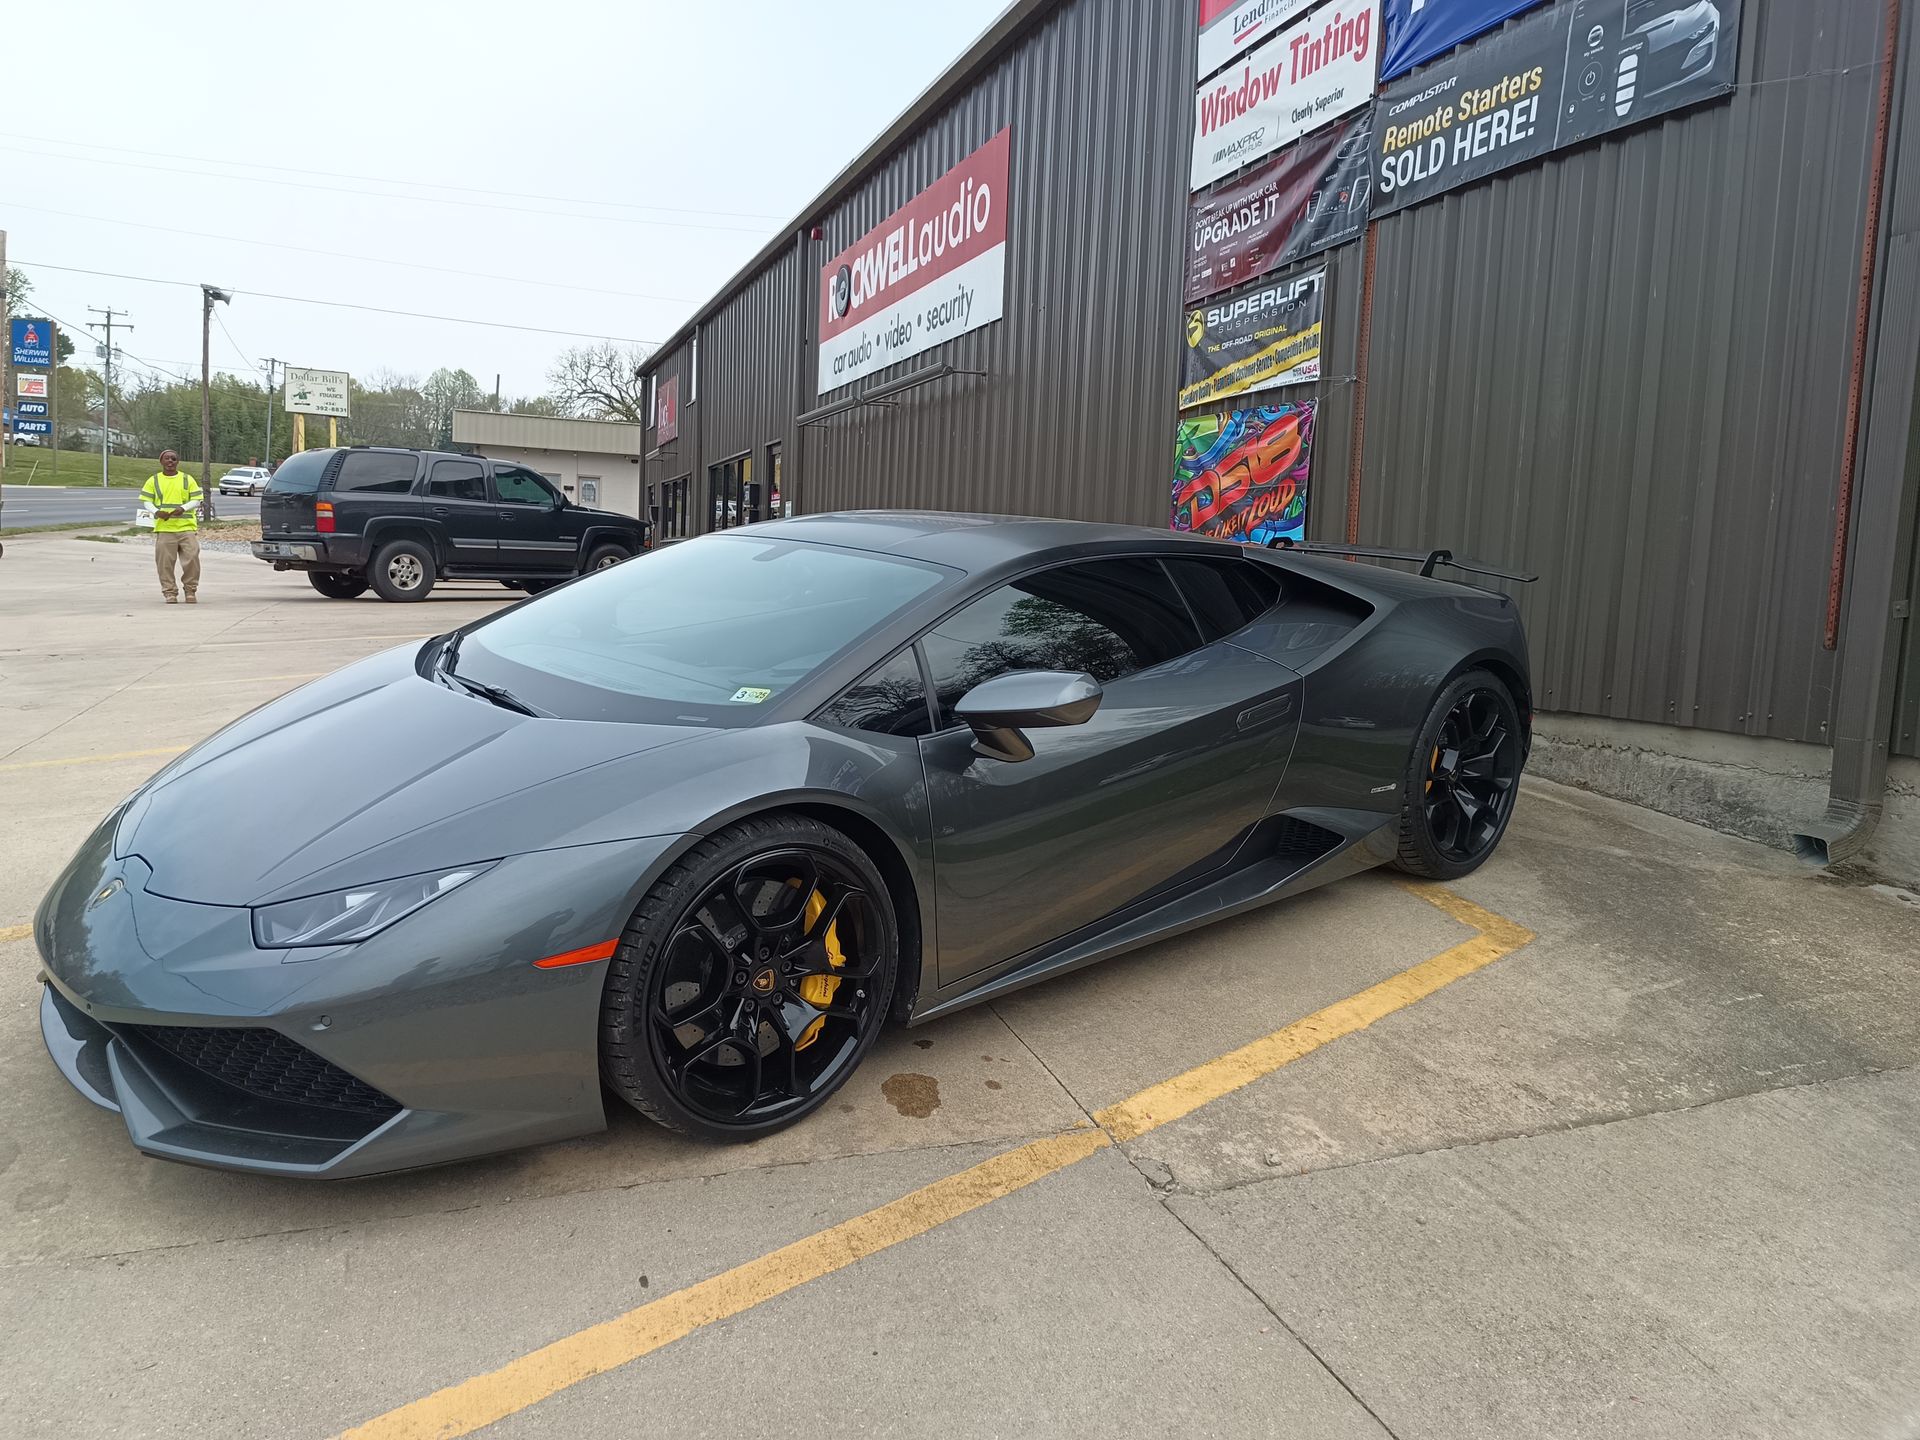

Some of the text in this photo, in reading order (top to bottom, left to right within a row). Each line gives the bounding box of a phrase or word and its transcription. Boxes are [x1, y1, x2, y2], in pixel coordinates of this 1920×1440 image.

[1200, 7, 1371, 138] Window Tinting
[1291, 87, 1345, 124] Clearly Superior
[1382, 66, 1543, 155] Remote Starters
[1388, 76, 1459, 117] COMPUSTAR
[1380, 94, 1540, 194] SOLD HERE!
[1248, 187, 1264, 203] YOUR
[1264, 181, 1279, 195] CAR
[1194, 192, 1280, 252] UPGRADE IT
[1206, 272, 1325, 328] SUPERLIFT
[1218, 299, 1308, 334] SUSPENSION
[833, 283, 974, 375] car audio video security
[1207, 324, 1288, 354] THE OFF-ROAD ORIGINAL
[14, 347, 49, 356] SHERWIN
[1301, 363, 1318, 375] USA
[290, 372, 318, 383] Dollar
[18, 421, 47, 431] PARTS
[20, 404, 45, 413] AUTO
[736, 691, 748, 699] 3
